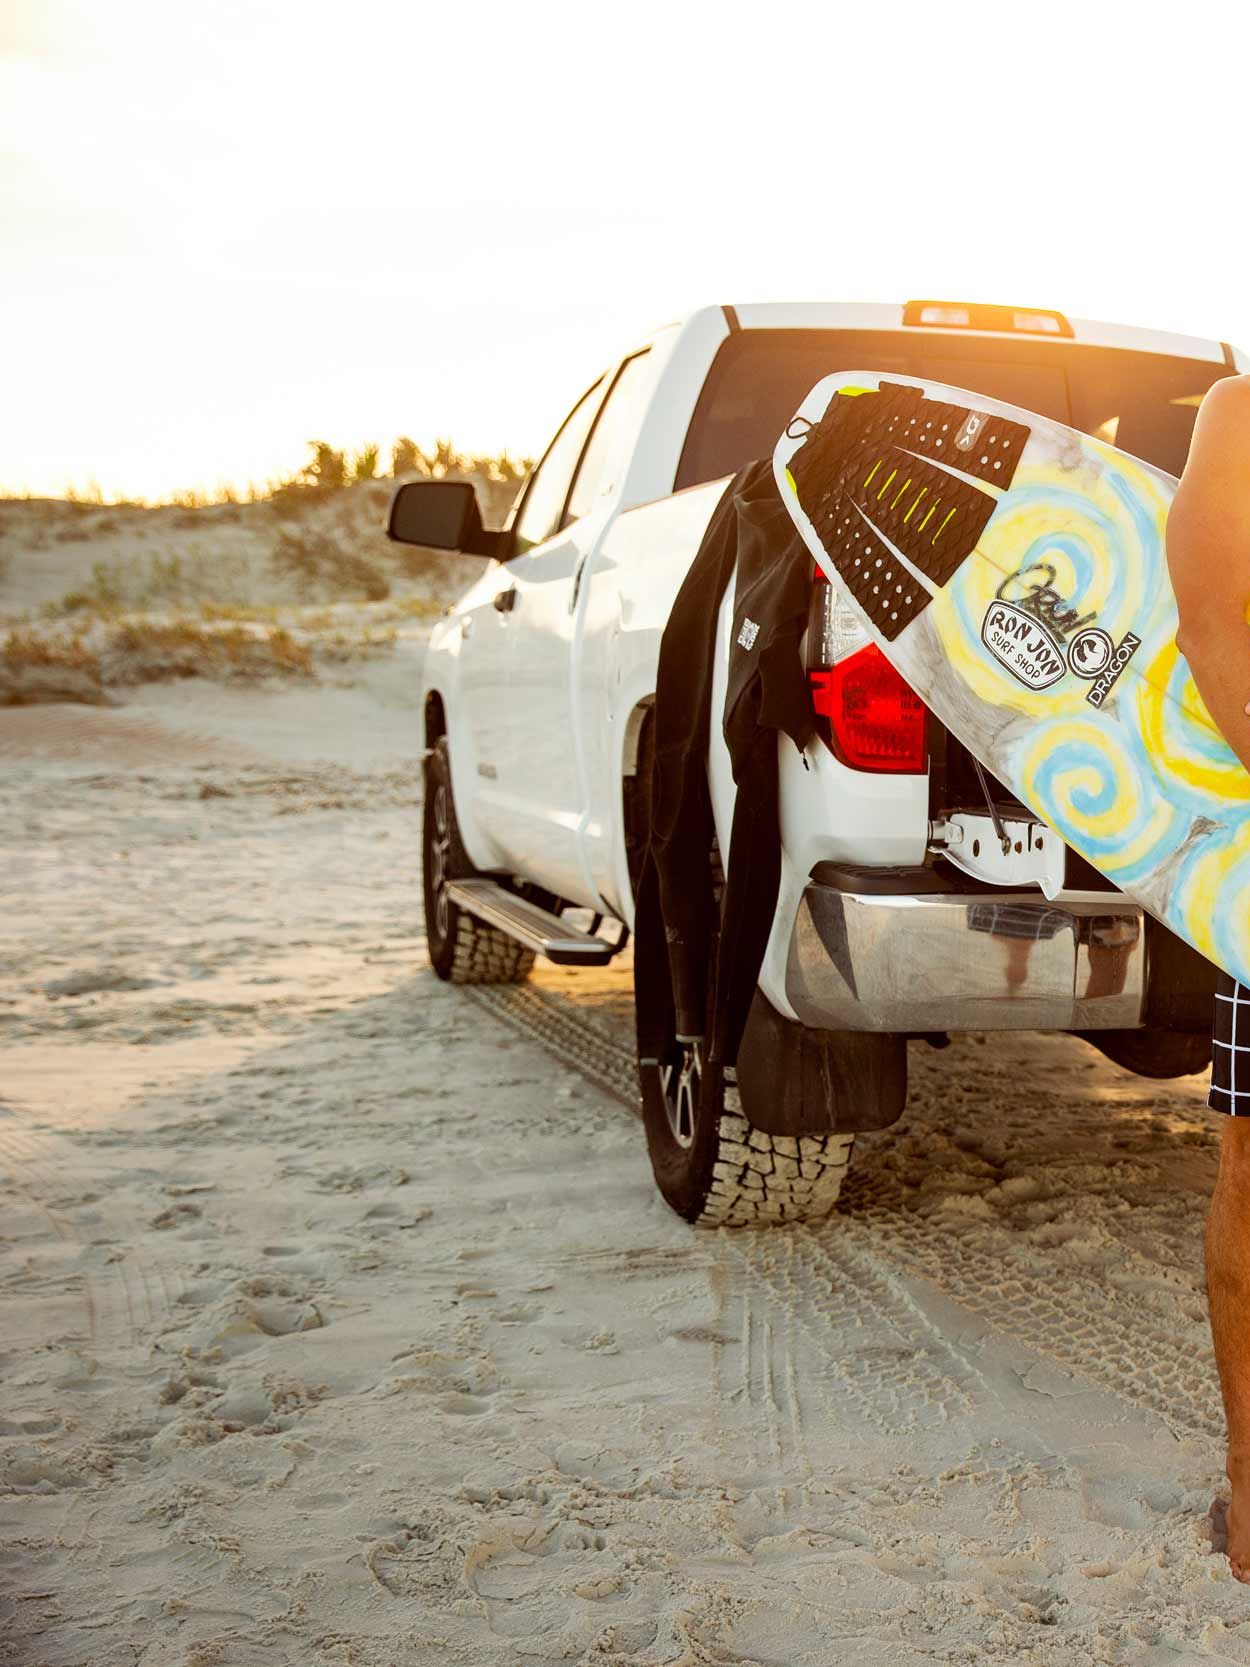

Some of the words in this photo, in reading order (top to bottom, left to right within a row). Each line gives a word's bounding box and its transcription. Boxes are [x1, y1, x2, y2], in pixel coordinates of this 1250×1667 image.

[989, 610, 1032, 642] RON
[1027, 639, 1060, 676] JON
[991, 631, 1014, 655] SURF
[1017, 654, 1041, 680] SHOP
[1088, 633, 1139, 705] DRAGON
